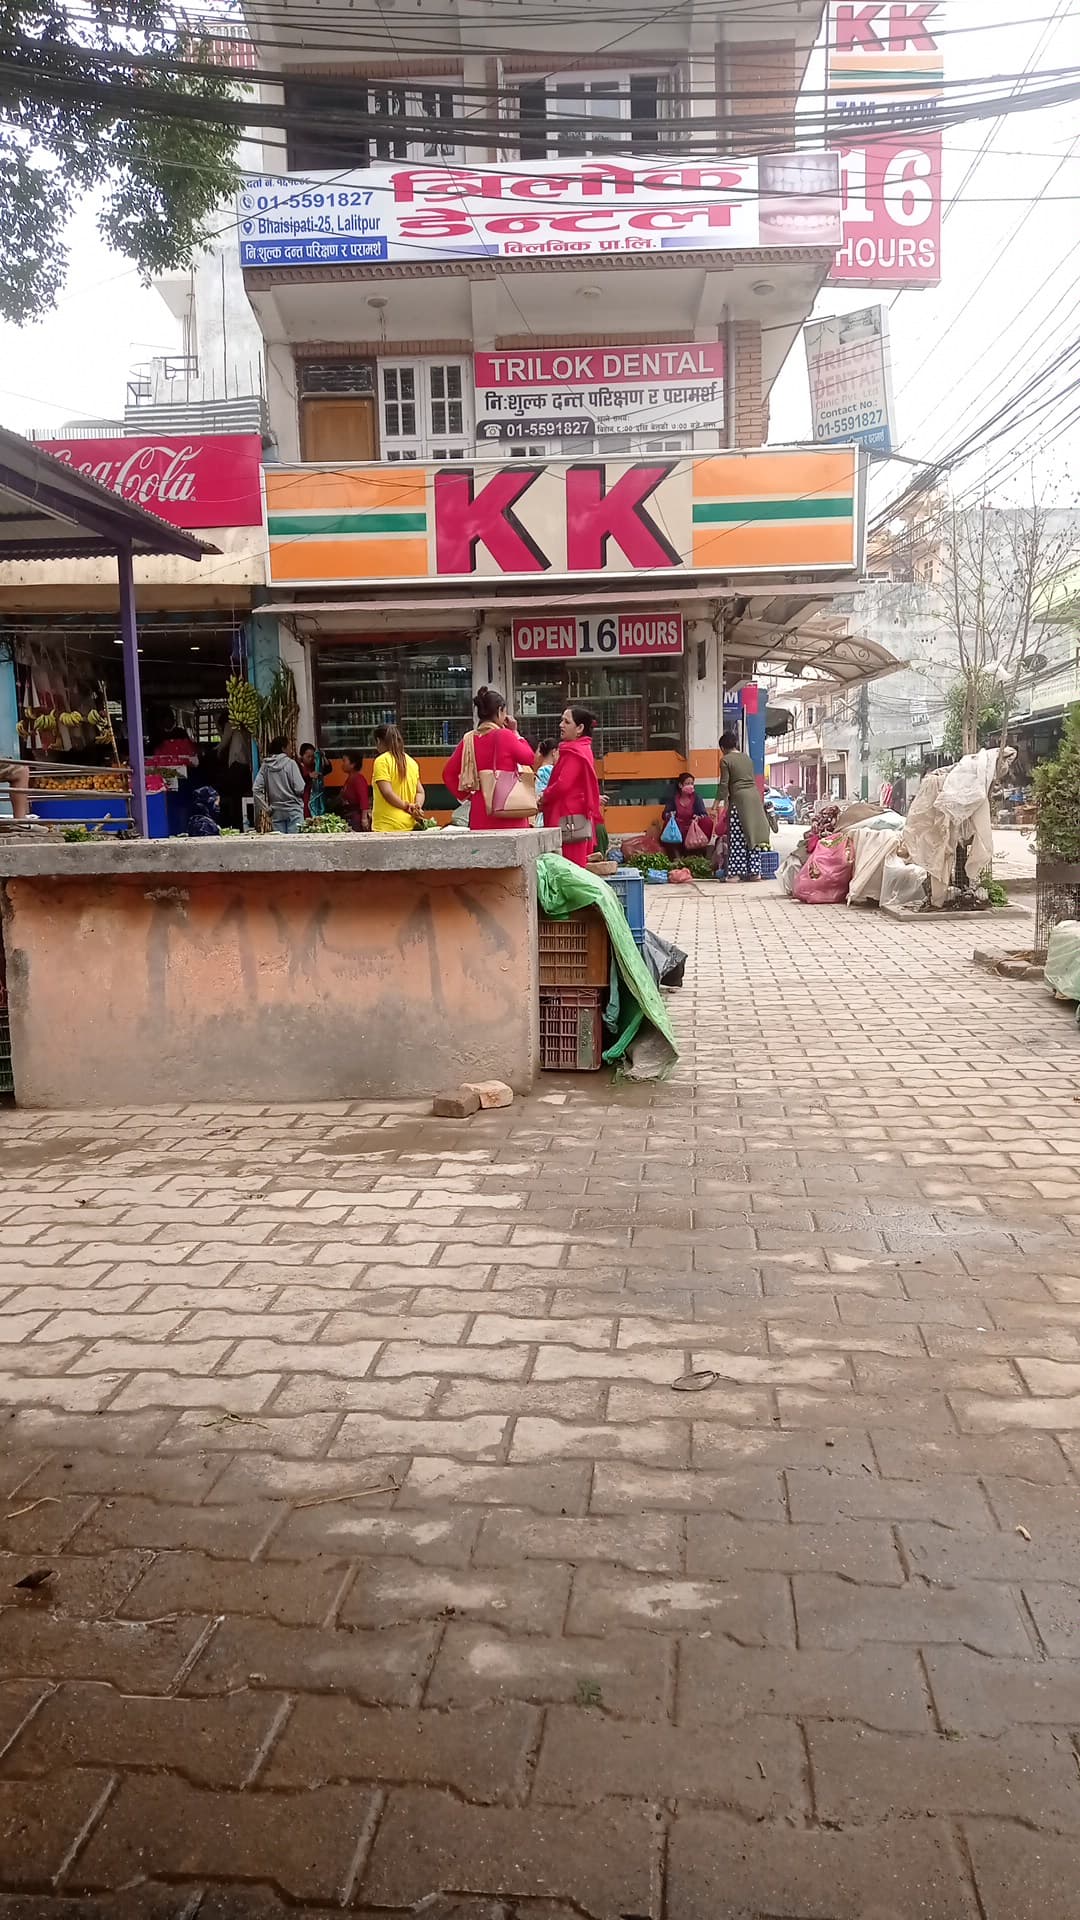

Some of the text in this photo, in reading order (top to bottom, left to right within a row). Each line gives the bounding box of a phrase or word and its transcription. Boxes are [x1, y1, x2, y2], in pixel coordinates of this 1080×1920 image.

[836, 4, 940, 52] KK
[389, 164, 748, 202] त्रिलोक
[842, 149, 933, 227] 16
[257, 191, 374, 210] 01-5591827
[258, 213, 381, 237] Bhaisipati-25, Lalitpur
[396, 204, 742, 237] डेन्टल
[284, 246, 303, 260] दन्त
[305, 240, 339, 259] परिक्षण
[340, 243, 349, 257] र
[504, 235, 657, 253] क्लिनिक प्रा.लि.
[836, 237, 936, 268] HOURS
[488, 350, 715, 381] TRILOK DENTAL
[551, 392, 584, 410] दन्त
[588, 387, 645, 408] परिक्षण
[648, 388, 660, 404] र
[662, 381, 718, 404] परामर्श
[814, 366, 881, 400] DENTAL
[816, 397, 839, 411] Clinic
[506, 421, 590, 437] 01-5591827
[817, 409, 883, 438] 01-5591827
[434, 462, 684, 574] KK
[518, 618, 678, 652] OPEN 16 HOURS
